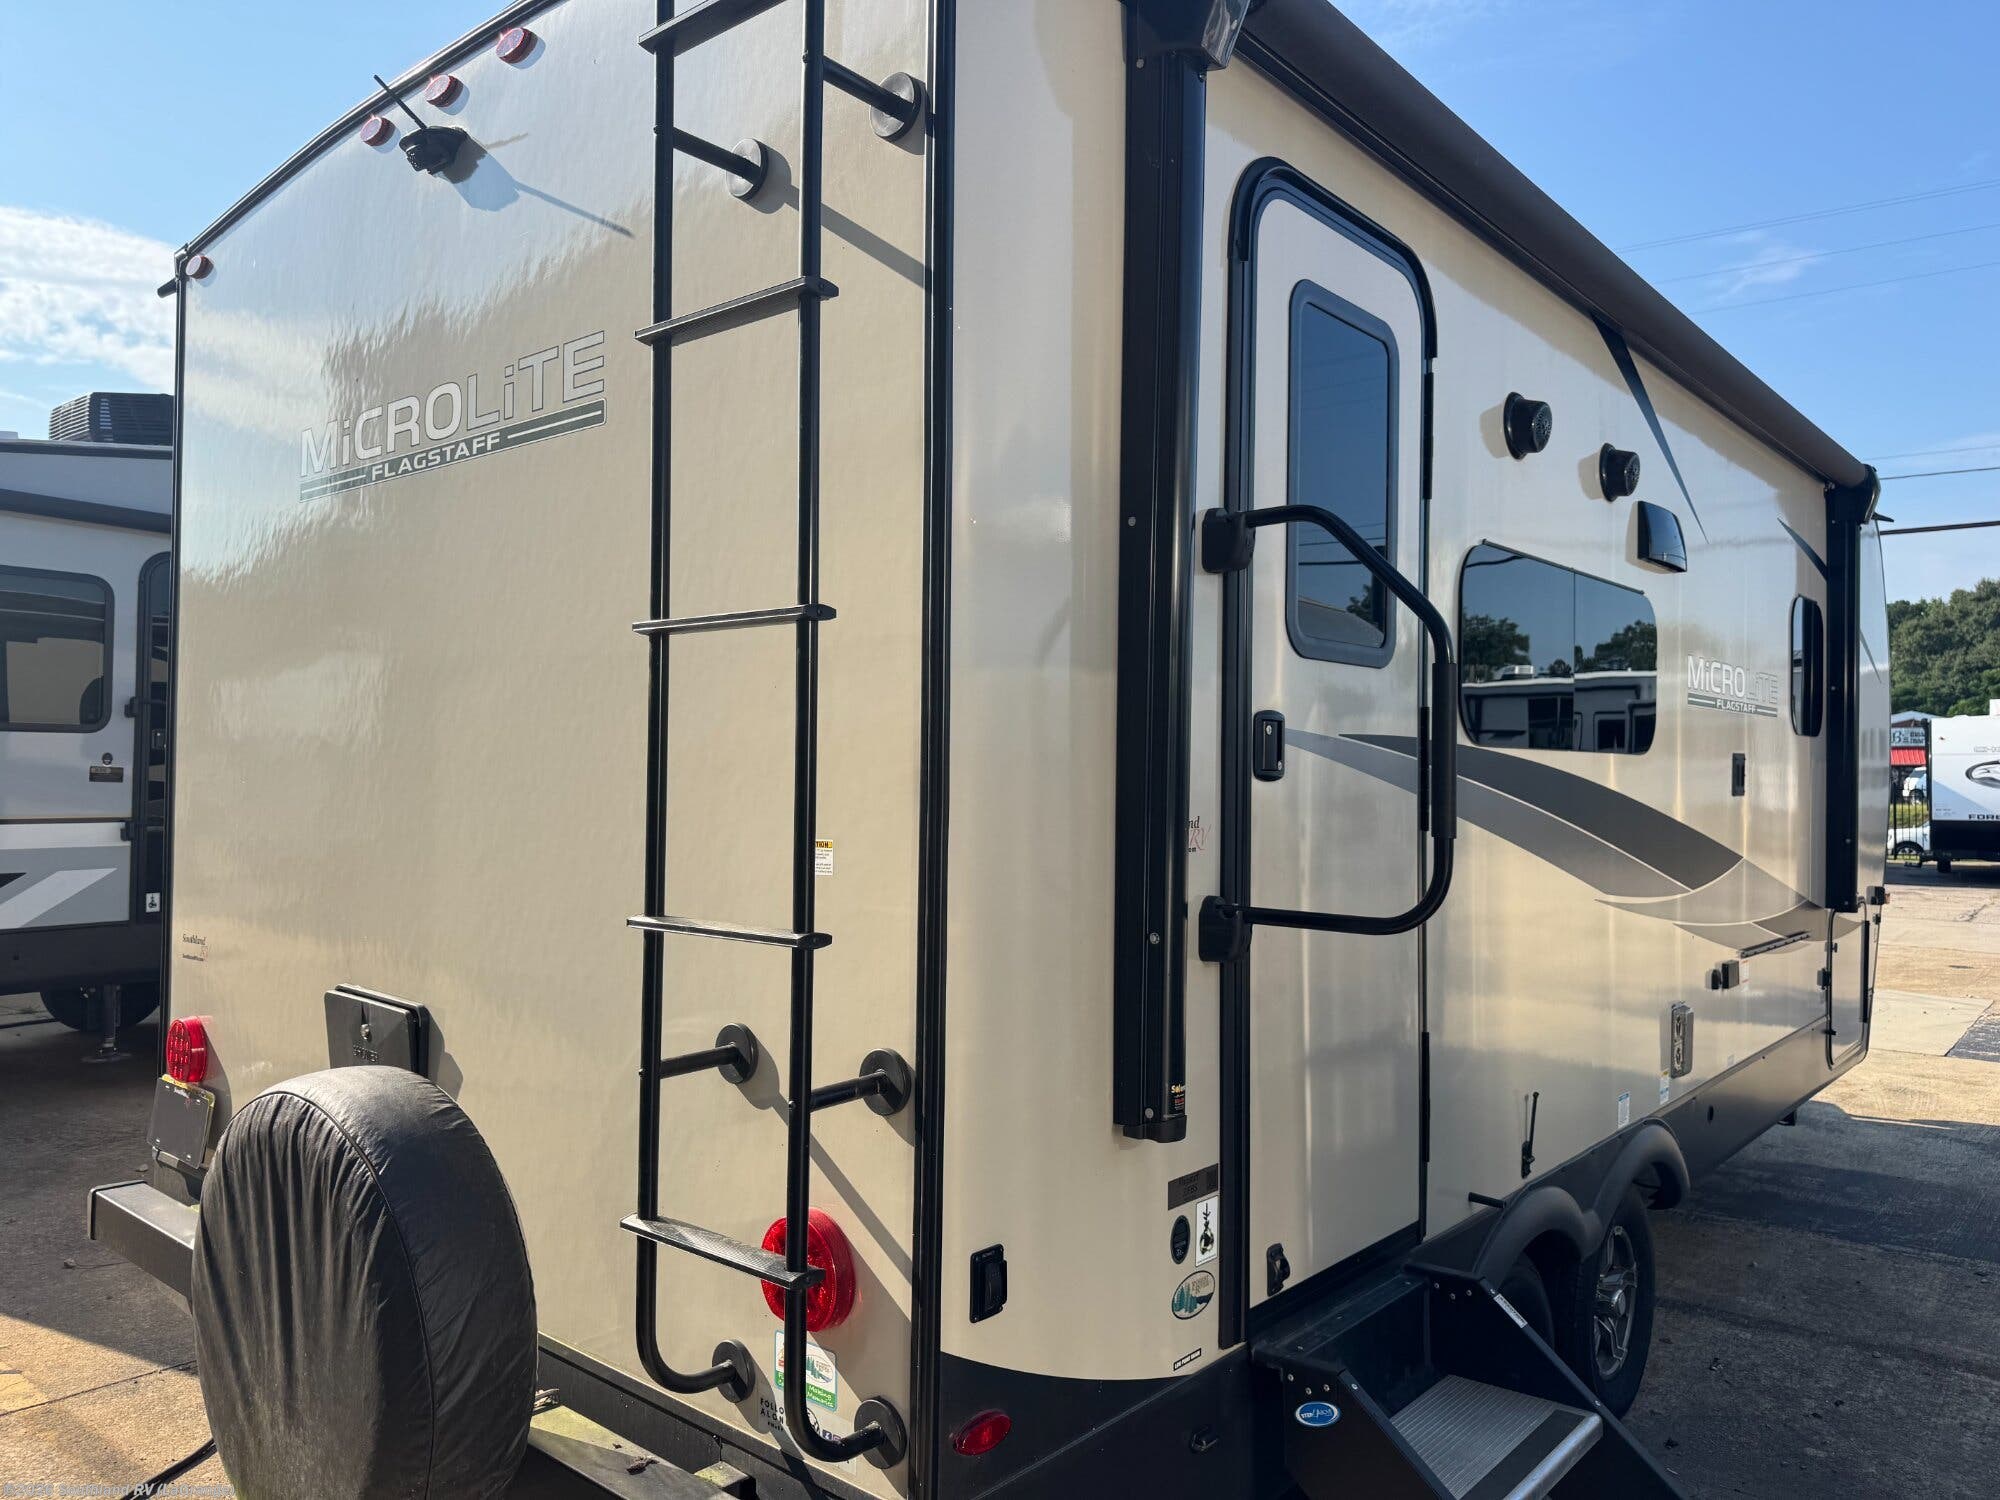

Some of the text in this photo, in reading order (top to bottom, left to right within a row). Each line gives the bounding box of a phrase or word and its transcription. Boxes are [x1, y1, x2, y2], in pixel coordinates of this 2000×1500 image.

[371, 433, 500, 481] FLAGSTAFF
[1716, 699, 1757, 713] FLAGSTAFF
[760, 1397, 785, 1414] FOLLO
[760, 1408, 785, 1425] ALON
